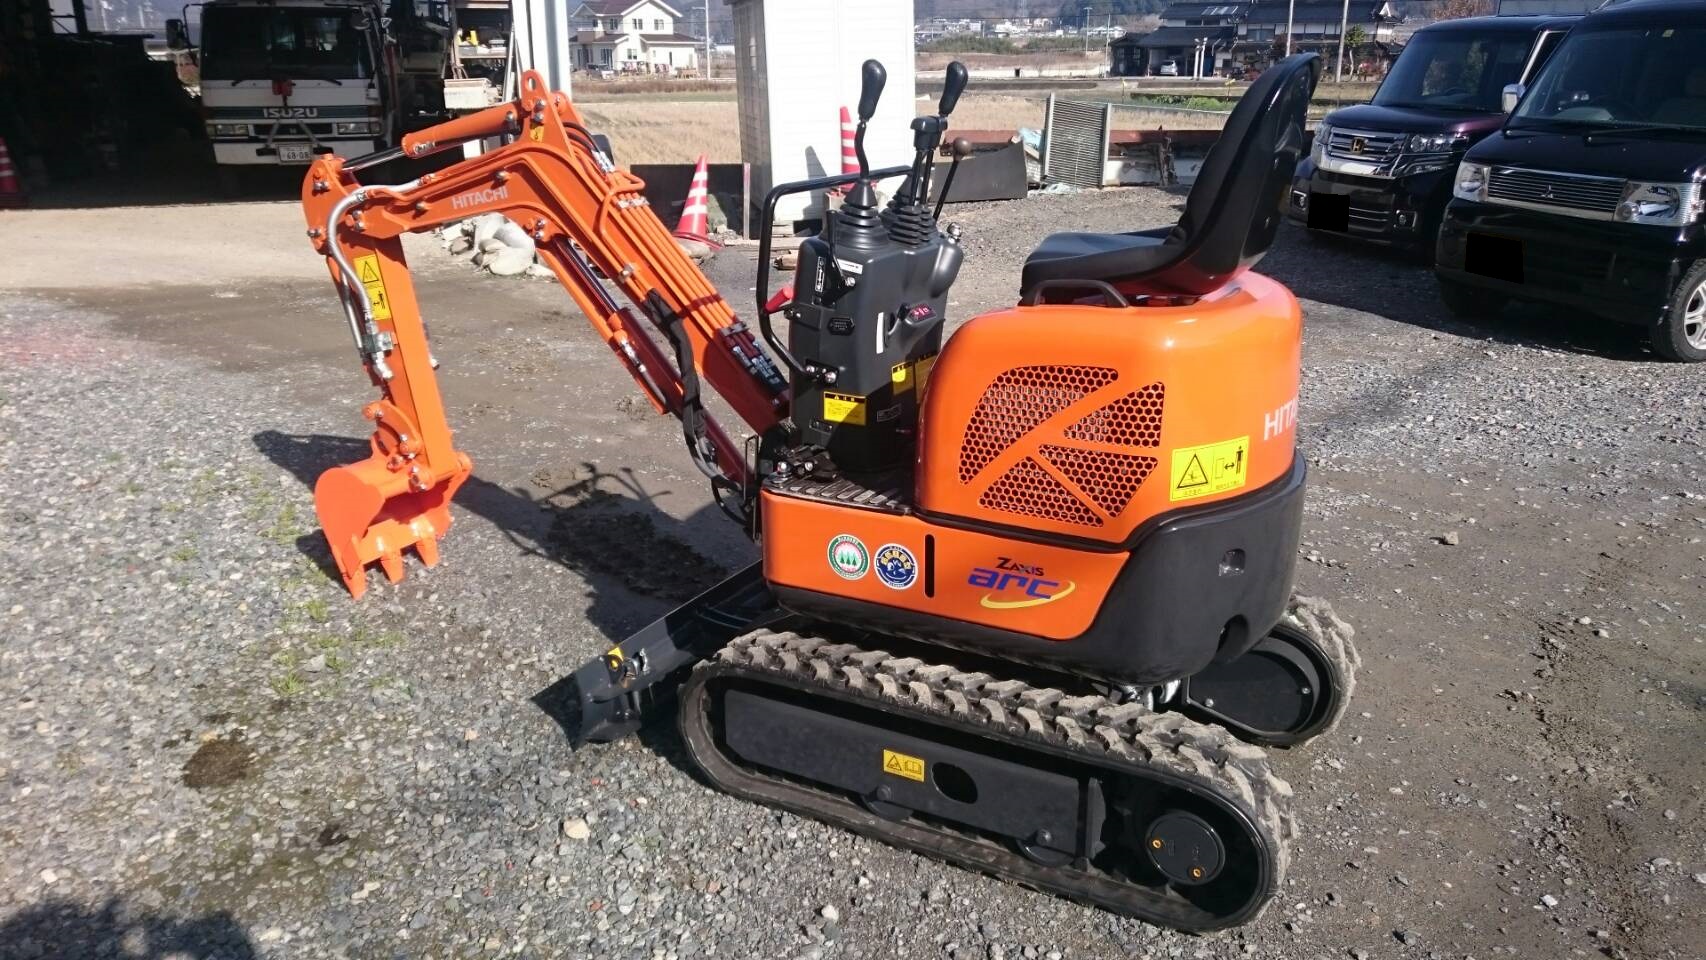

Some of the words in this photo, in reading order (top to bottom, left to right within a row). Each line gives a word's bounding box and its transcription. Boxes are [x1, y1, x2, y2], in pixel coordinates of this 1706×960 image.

[263, 107, 318, 118] ISUZU
[452, 186, 508, 209] HITACHI
[996, 557, 1044, 576] ZAXIS
[968, 568, 1060, 599] arc
